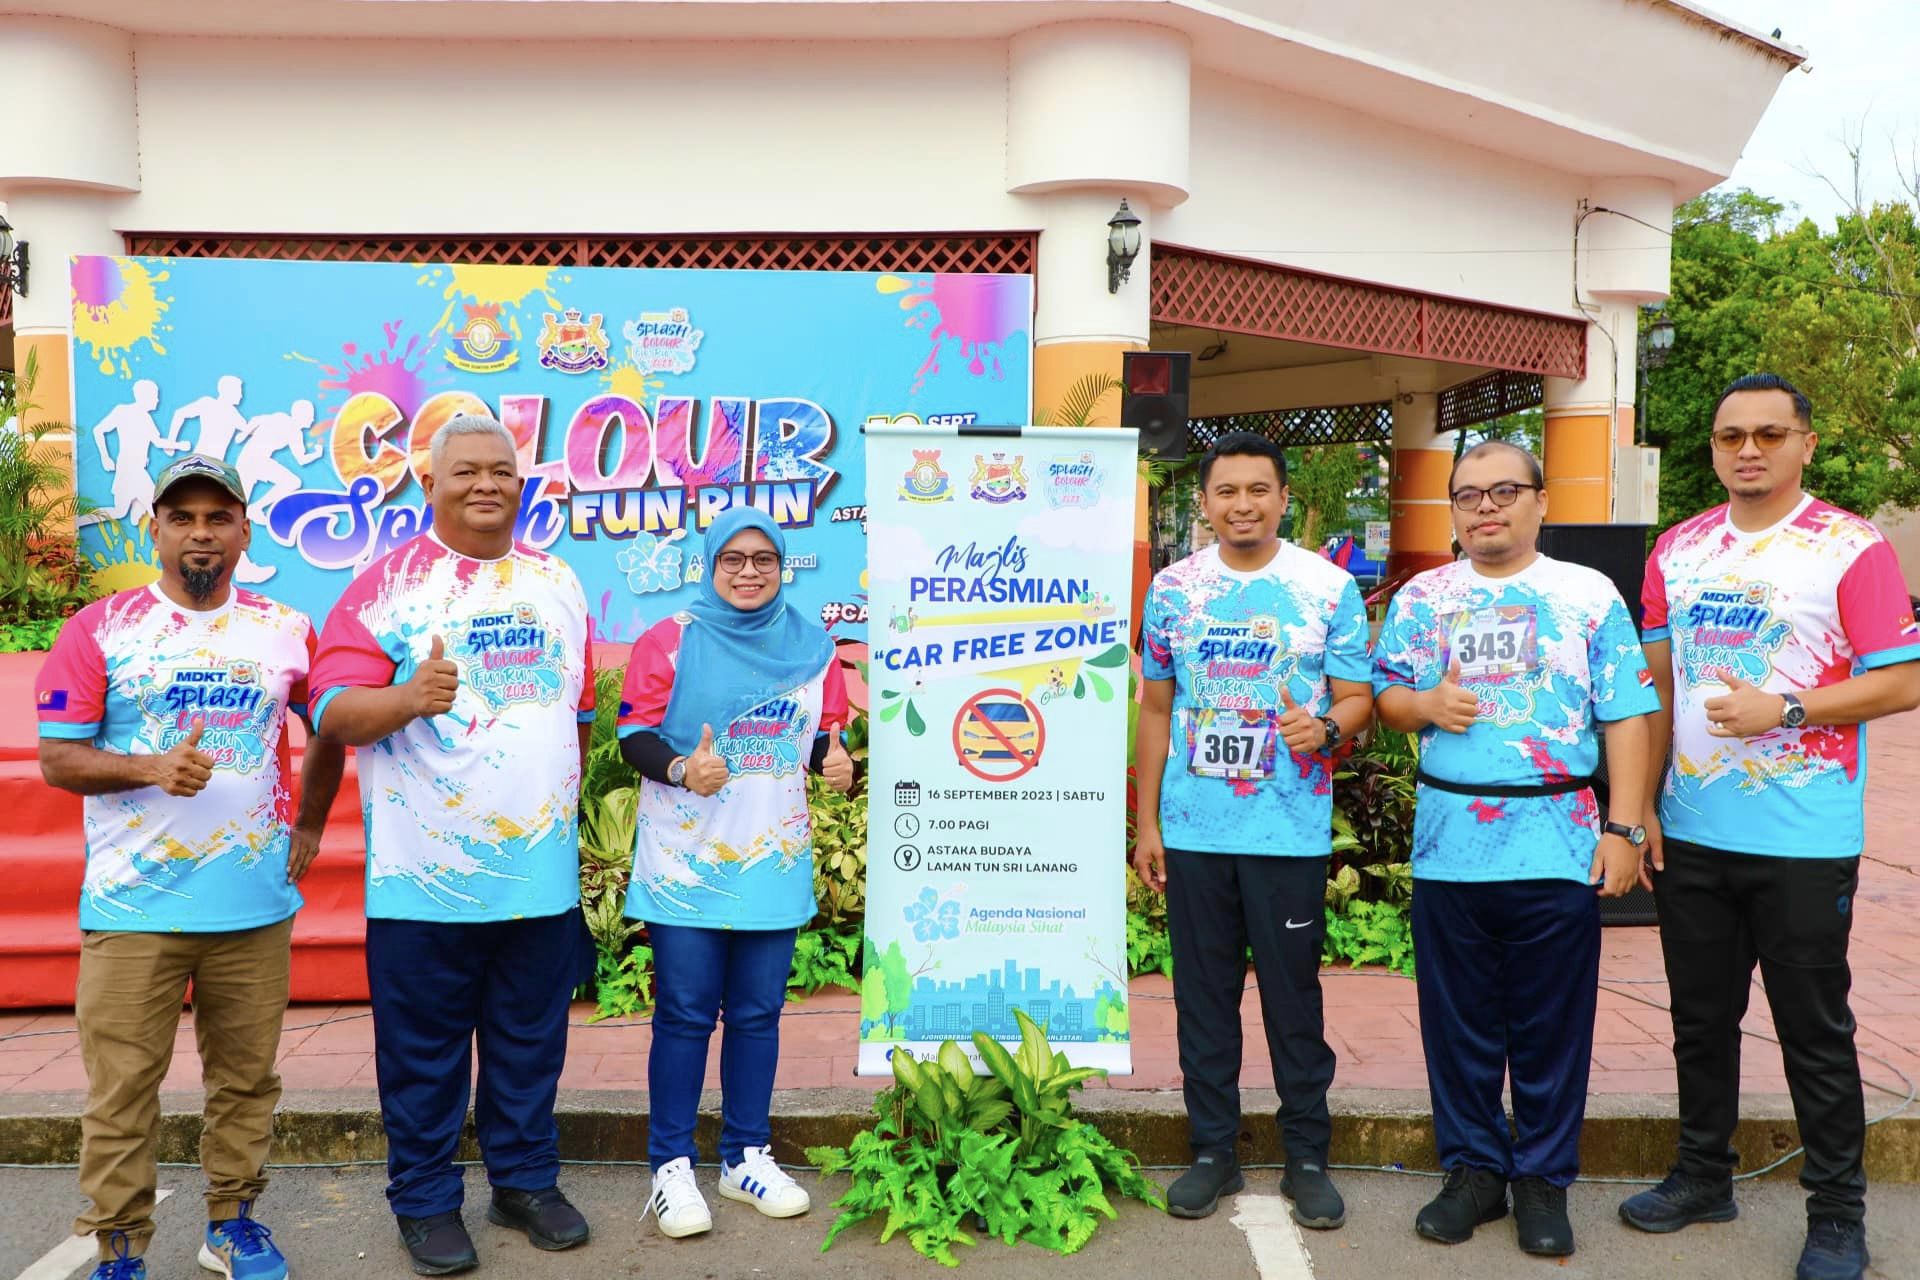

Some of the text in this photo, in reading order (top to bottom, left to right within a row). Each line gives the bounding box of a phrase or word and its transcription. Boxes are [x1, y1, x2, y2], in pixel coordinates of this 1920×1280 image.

[570, 479, 814, 538] FUN RUN
[936, 535, 1028, 585] Majlis
[910, 577, 1089, 604] PERASMIAN
[1700, 592, 1744, 603] MDKT
[472, 614, 514, 628] MDKT
[1688, 603, 1769, 632] SPLASH
[1208, 627, 1251, 637] MDKT
[468, 628, 546, 654] SPLASH
[953, 632, 1026, 662] FREE
[1458, 631, 1516, 664] 343
[1198, 640, 1279, 664] SPLASH
[176, 671, 227, 682] MDKT
[165, 686, 262, 711] SPLASH
[505, 684, 537, 698] 2023
[1204, 734, 1255, 765] 367
[742, 755, 773, 767] 2023
[928, 790, 941, 800] 16
[943, 790, 1018, 801] SEPTEMBER
[1021, 791, 1053, 801] 2023
[1063, 791, 1105, 802] SABTU
[928, 820, 990, 831] 7.00 PAGI
[927, 846, 1032, 856] ASTAKA BUDAYA
[927, 862, 1078, 873] LAMAN TUN SRI LANANG
[969, 906, 1086, 921] Agenda Nasional
[965, 920, 1064, 935] Malaysia Sihat
